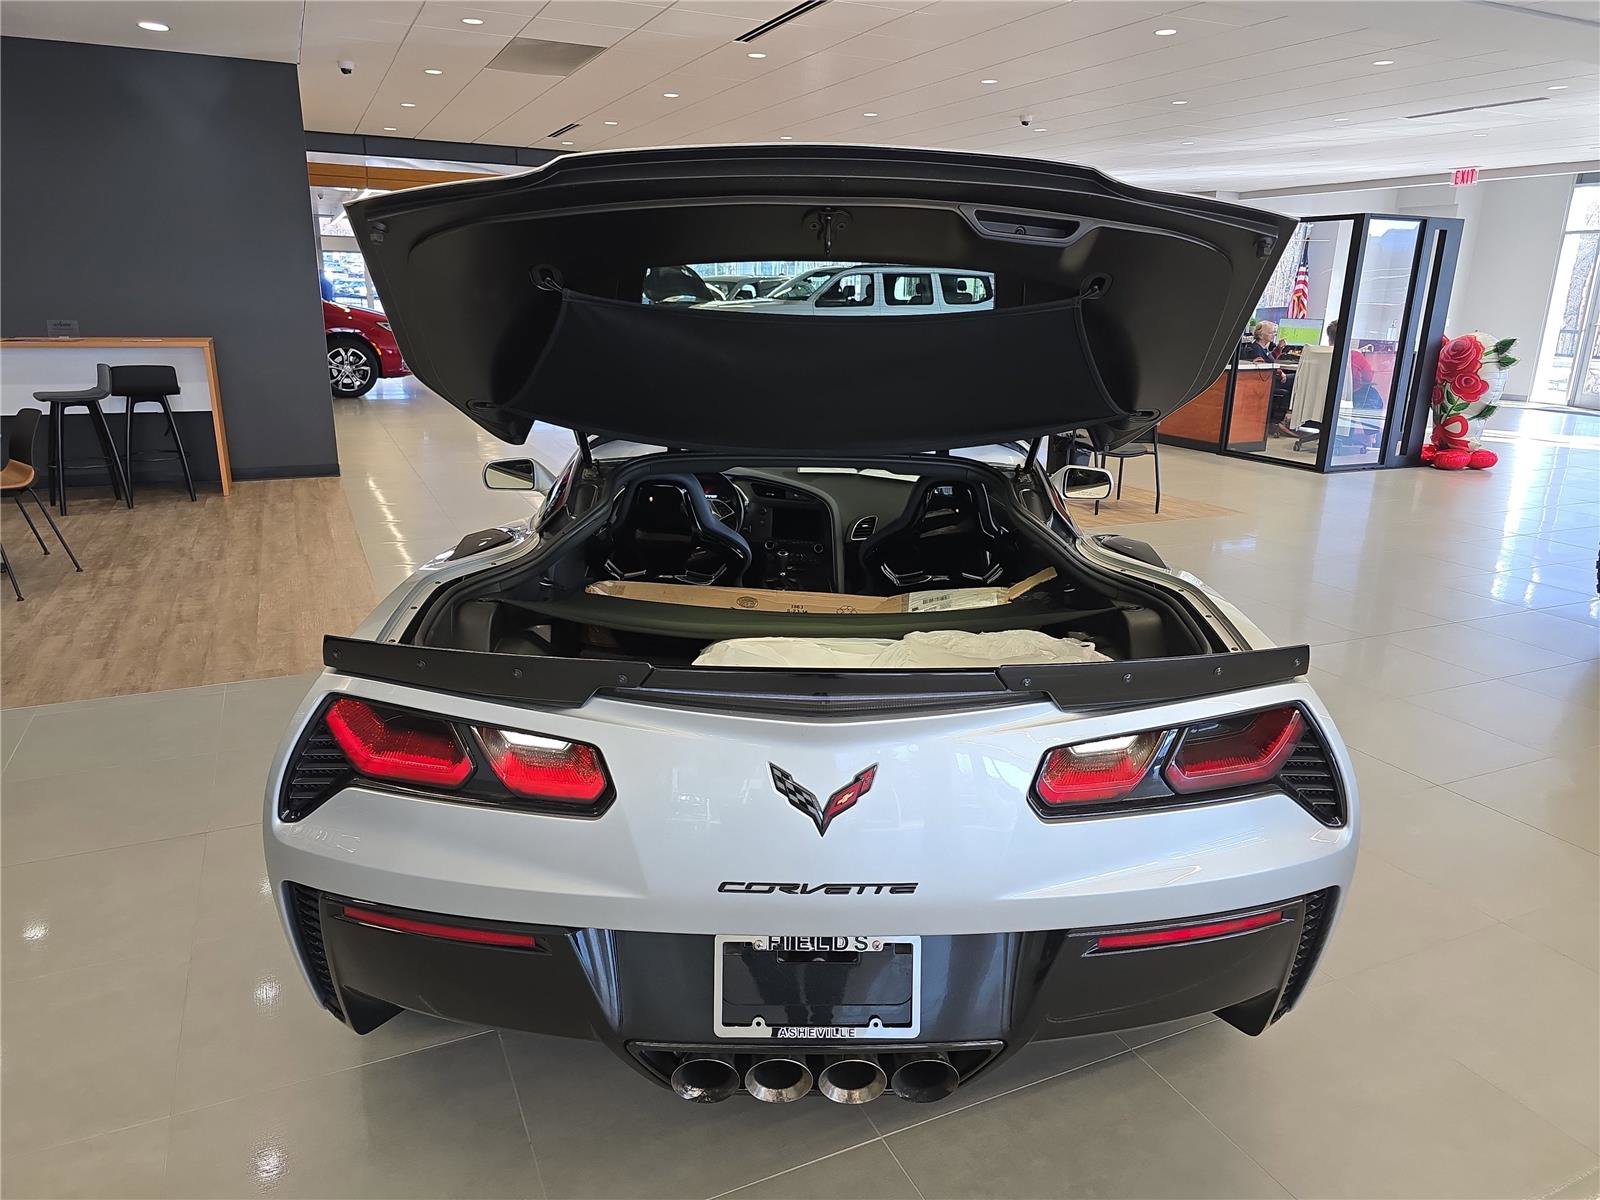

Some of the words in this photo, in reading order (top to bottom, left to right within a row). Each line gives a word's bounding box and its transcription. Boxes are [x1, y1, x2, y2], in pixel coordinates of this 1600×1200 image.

[1455, 169, 1476, 184] EXIT
[717, 881, 918, 895] CORVETTE
[767, 935, 868, 951] FIELDS
[777, 1027, 856, 1038] ASHEVILLE
